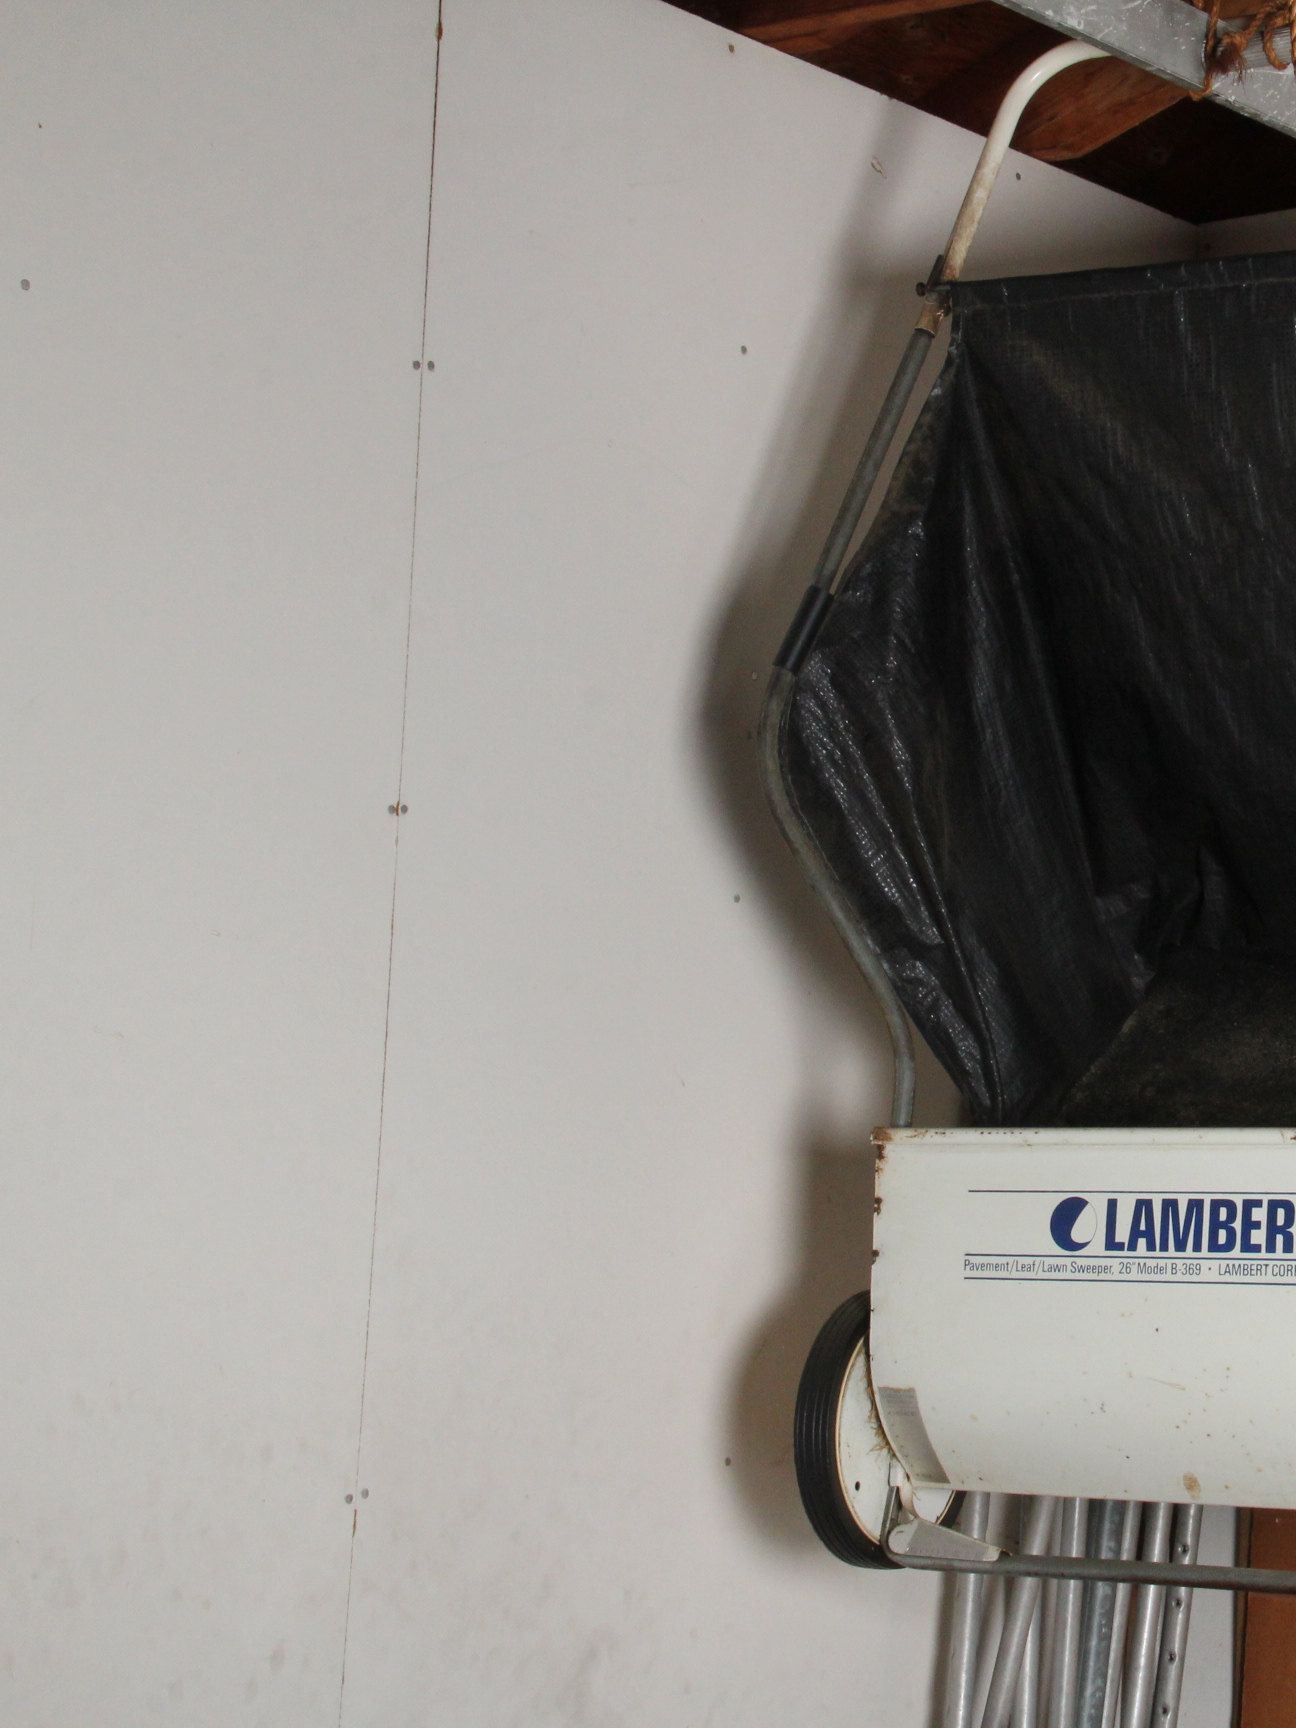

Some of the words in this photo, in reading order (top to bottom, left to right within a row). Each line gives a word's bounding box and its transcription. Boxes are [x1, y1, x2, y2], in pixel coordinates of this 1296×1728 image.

[963, 1258, 1068, 1275] Pavement/Leaf/Lawn
[1070, 1260, 1115, 1277] Sweeper,
[1136, 1261, 1168, 1275] Model
[1170, 1262, 1202, 1276] B-369
[1218, 1263, 1270, 1277] LAMBERT
